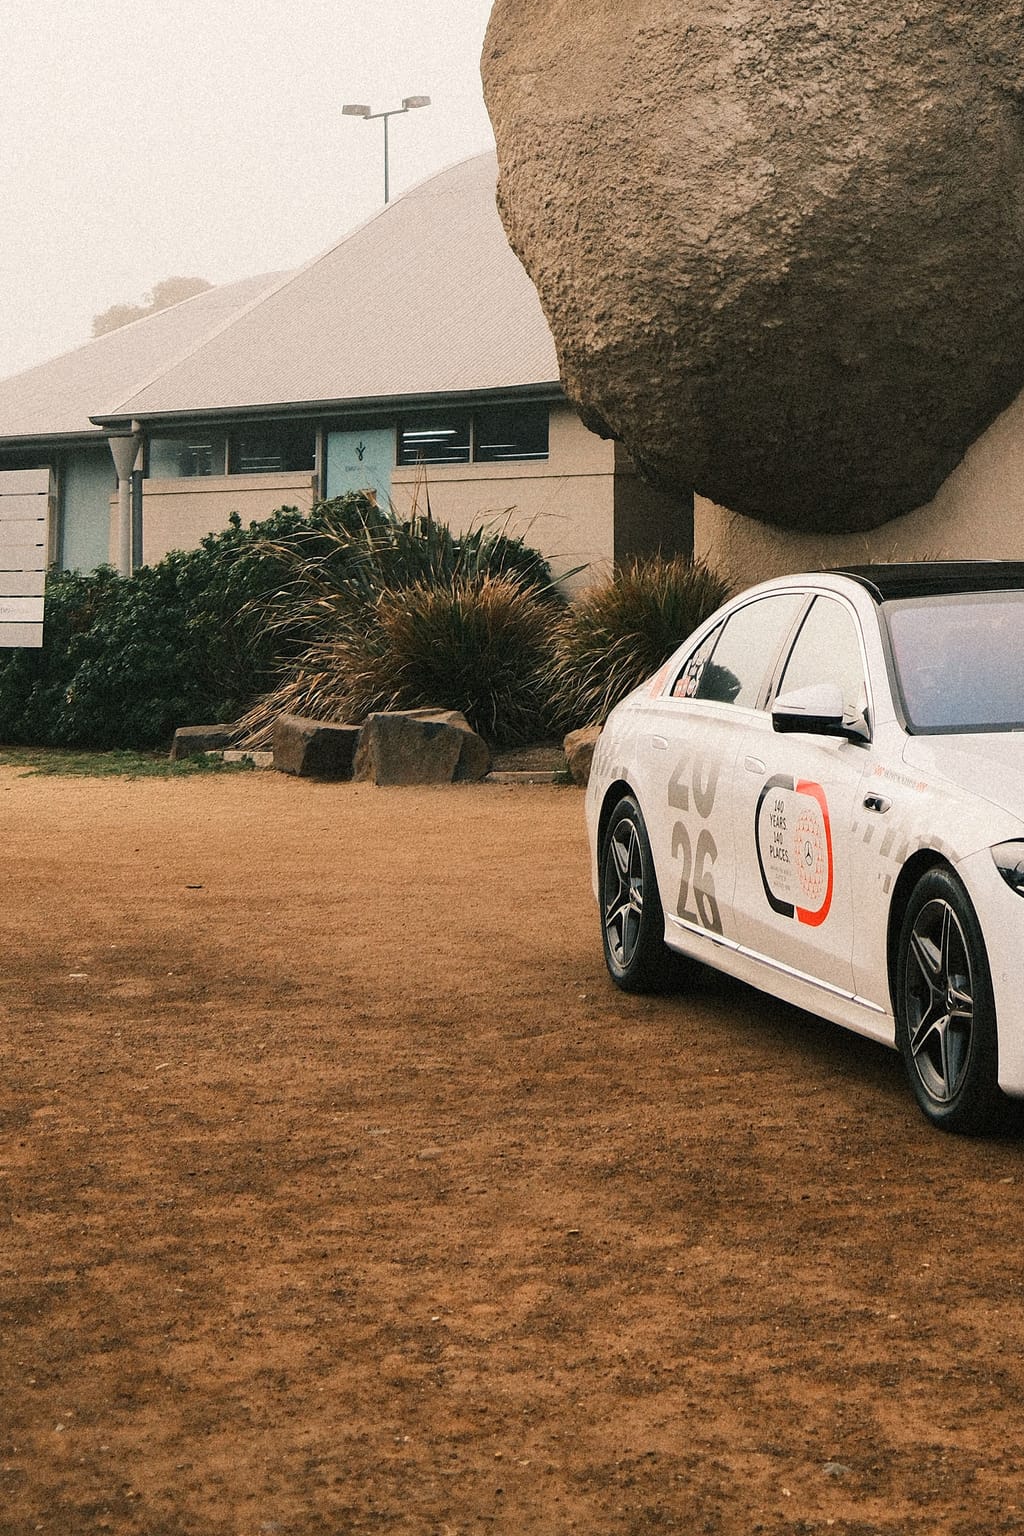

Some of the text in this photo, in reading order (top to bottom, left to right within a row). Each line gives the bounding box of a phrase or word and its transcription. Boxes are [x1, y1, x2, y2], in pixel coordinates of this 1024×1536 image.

[773, 799, 785, 814] 140
[769, 813, 788, 831] YEARS.
[773, 831, 784, 845] 140
[769, 844, 791, 864] PLACES.
[671, 820, 724, 937] 26
